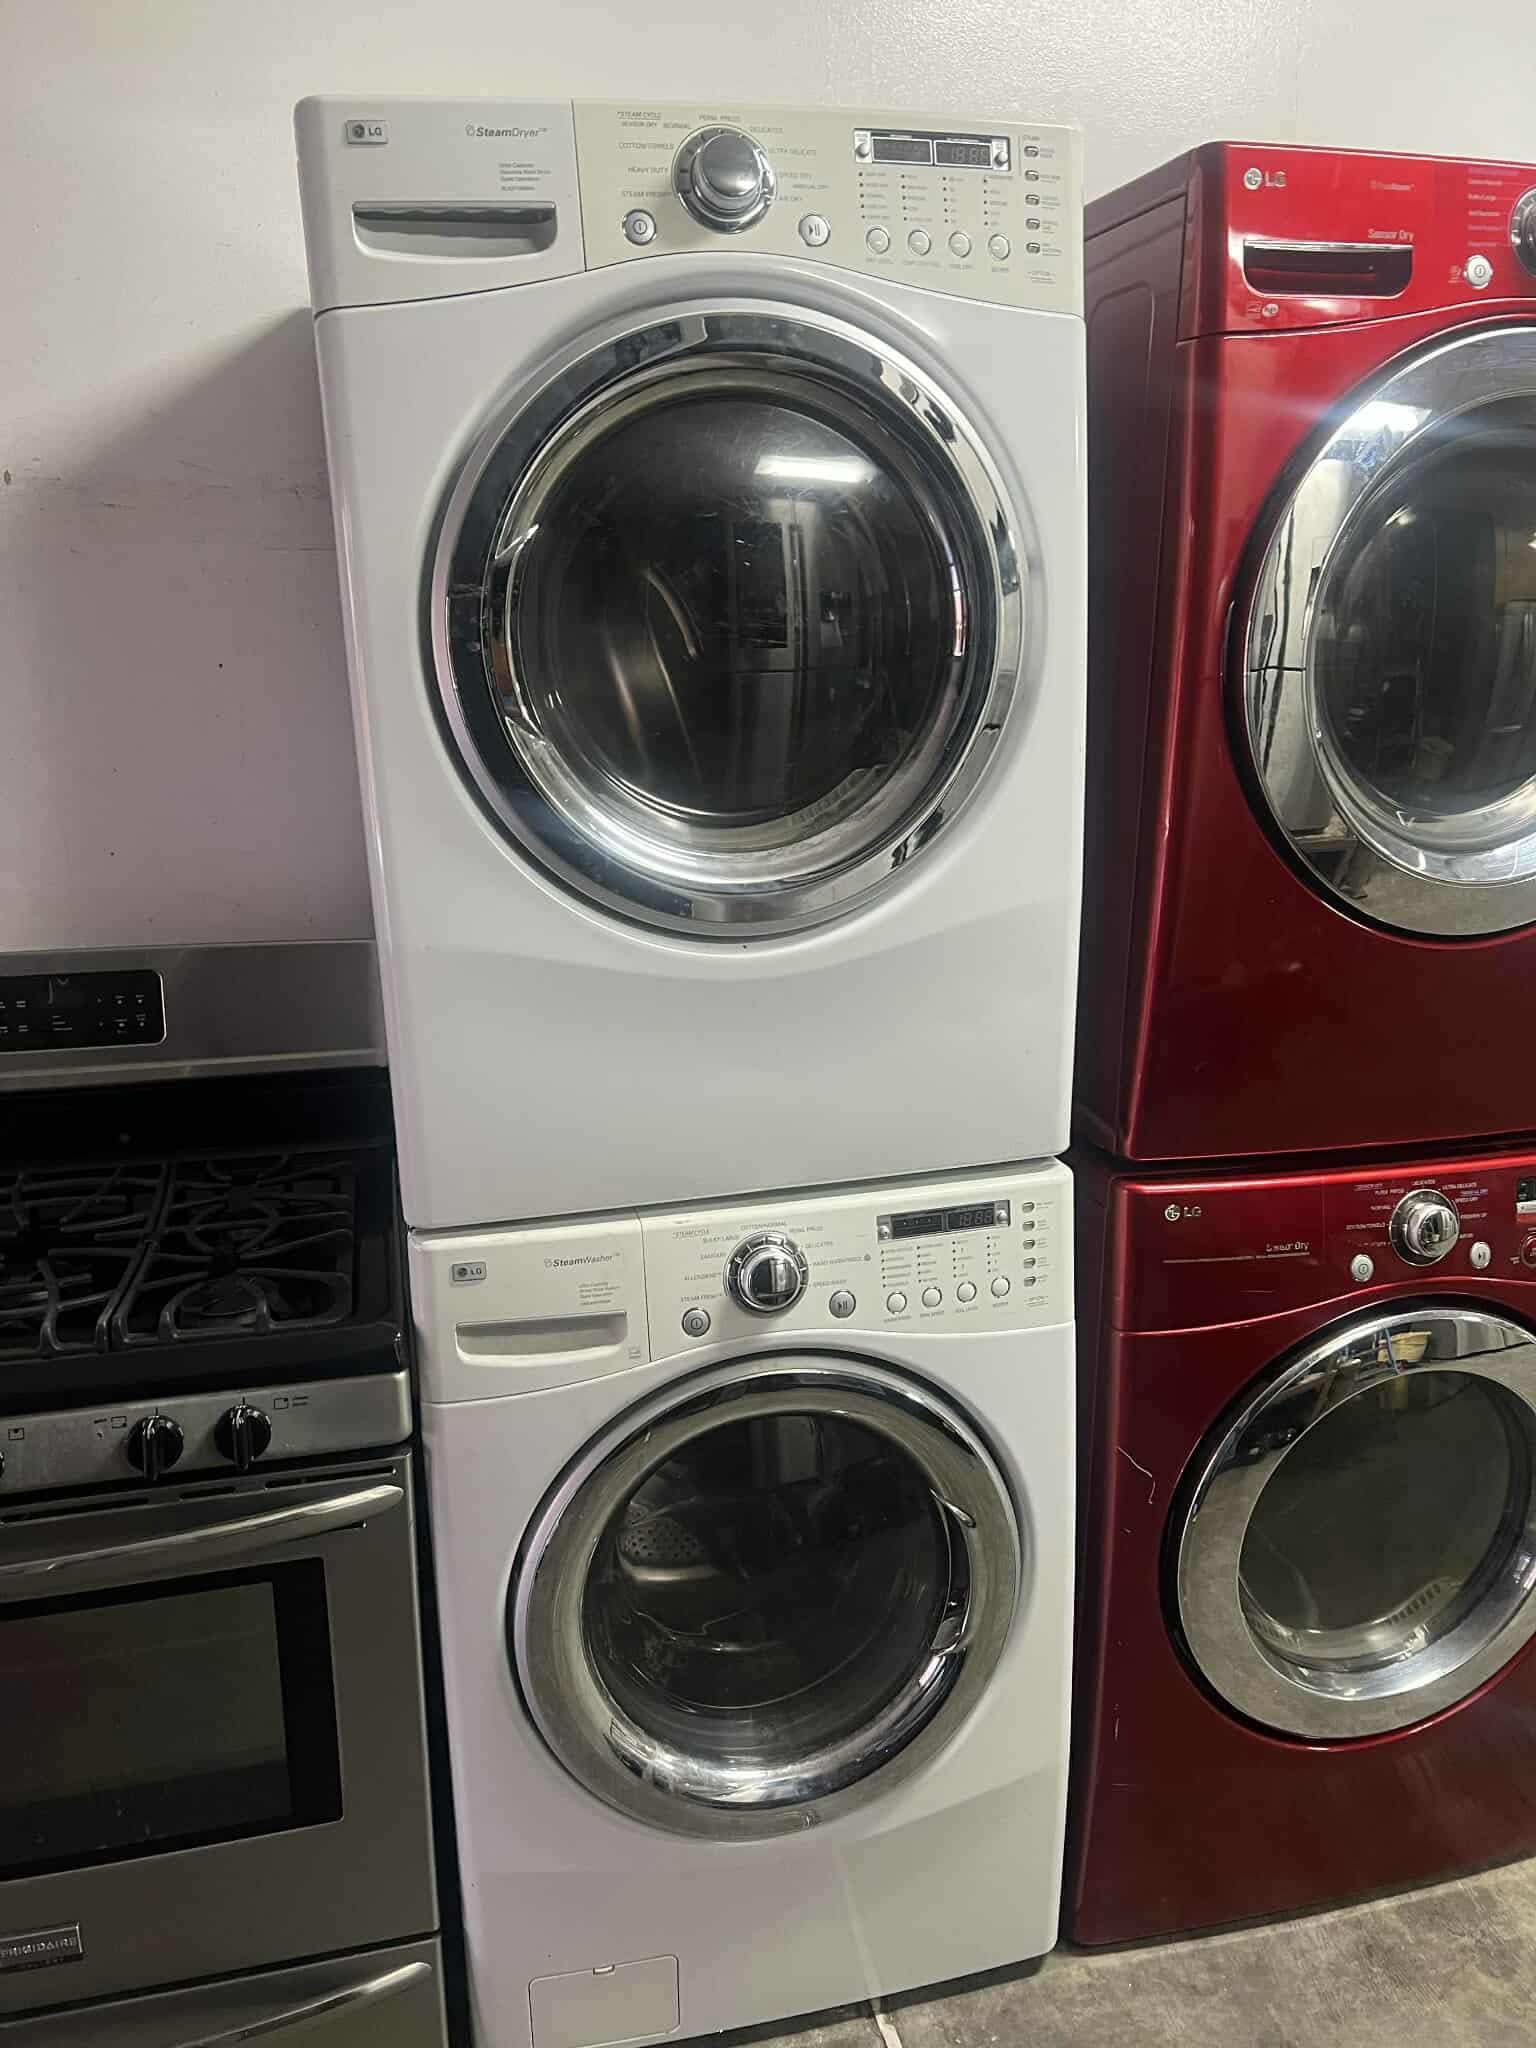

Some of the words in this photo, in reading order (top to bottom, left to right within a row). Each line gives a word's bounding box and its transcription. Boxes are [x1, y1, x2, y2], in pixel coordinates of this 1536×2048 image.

[368, 126, 383, 137] LG
[1264, 170, 1287, 188] LG
[1368, 228, 1398, 240] Sensor
[1399, 229, 1415, 242] Dry
[1183, 1205, 1202, 1217] LG
[1294, 1241, 1310, 1251] Dry
[470, 1267, 483, 1276] LG
